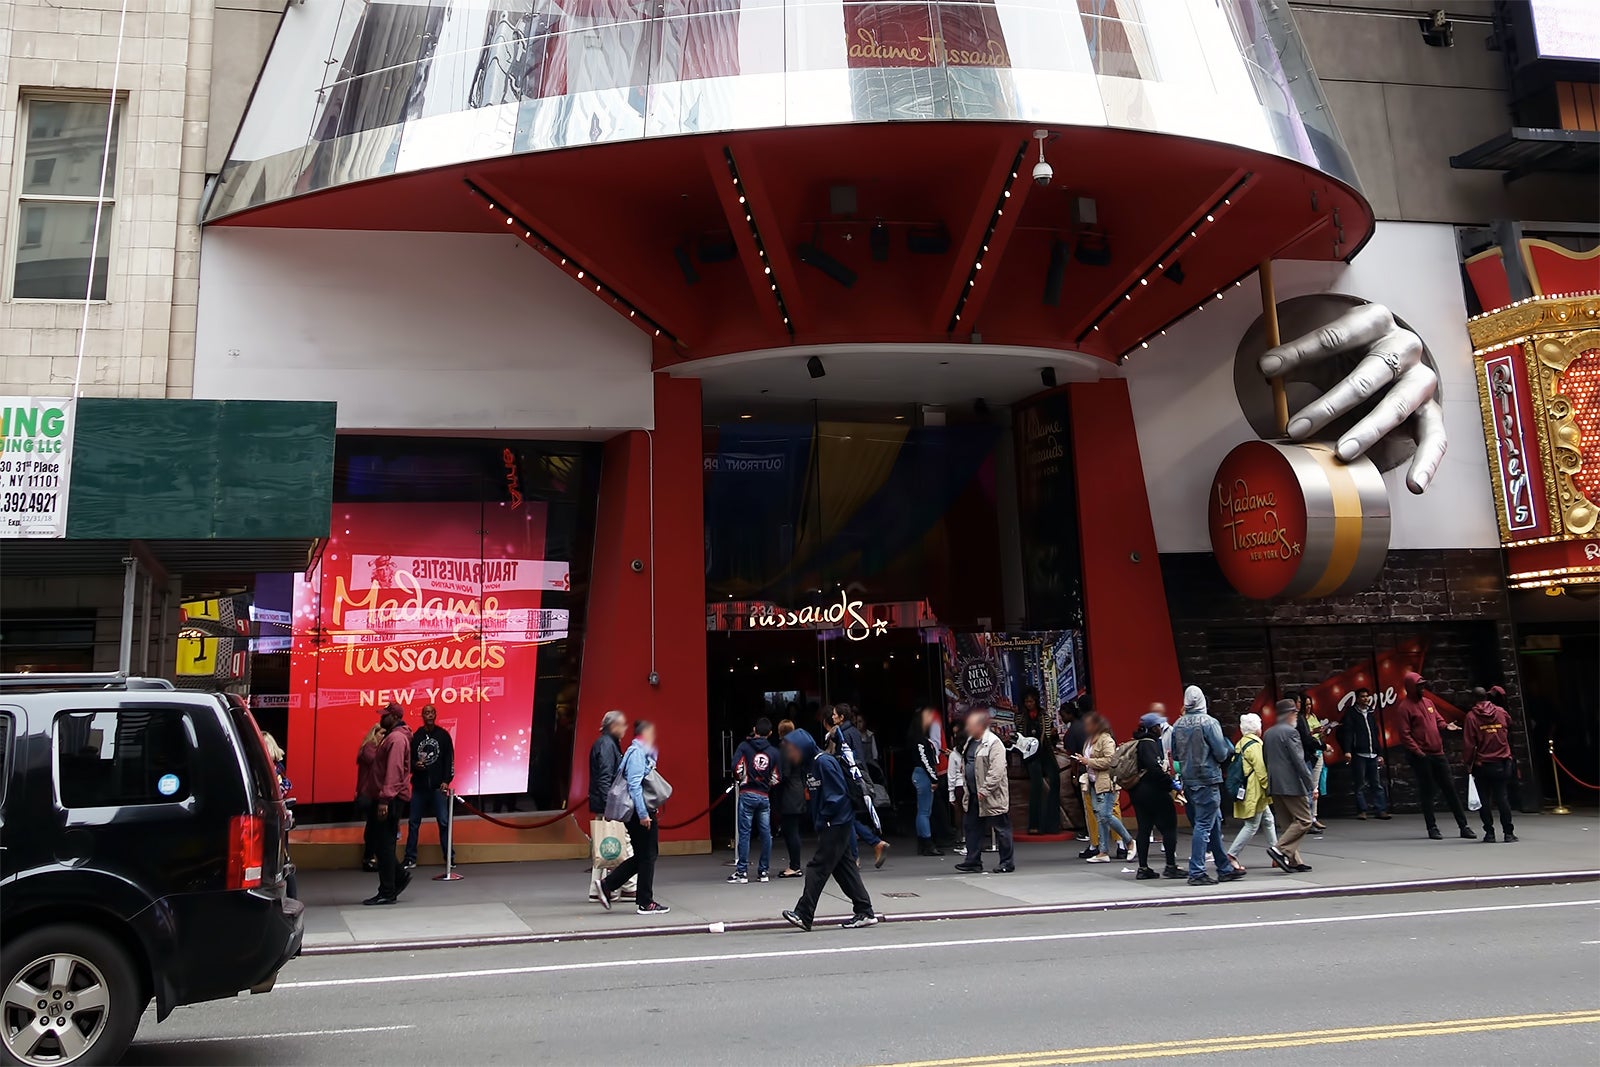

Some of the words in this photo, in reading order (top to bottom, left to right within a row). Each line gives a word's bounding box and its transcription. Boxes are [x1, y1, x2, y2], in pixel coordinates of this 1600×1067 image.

[847, 28, 927, 62] adame
[38, 440, 61, 453] LLC
[15, 461, 32, 472] 31st
[33, 461, 59, 473] Place
[9, 475, 24, 487] NY
[28, 475, 58, 487] 11101
[0, 492, 57, 513] .392.4921
[1217, 478, 1276, 517] Madame
[22, 514, 53, 522] 12/31/18
[1223, 510, 1292, 560] Tussauds
[1264, 549, 1279, 559] YORK
[1584, 543, 1600, 561] R
[331, 570, 509, 627] Madame
[750, 605, 774, 618] 234
[985, 637, 1014, 647] Madame
[305, 622, 507, 677] Tussauds
[968, 668, 989, 681] NEW
[968, 678, 993, 690] YORK
[359, 689, 415, 707] NEW
[426, 686, 491, 704] YORK
